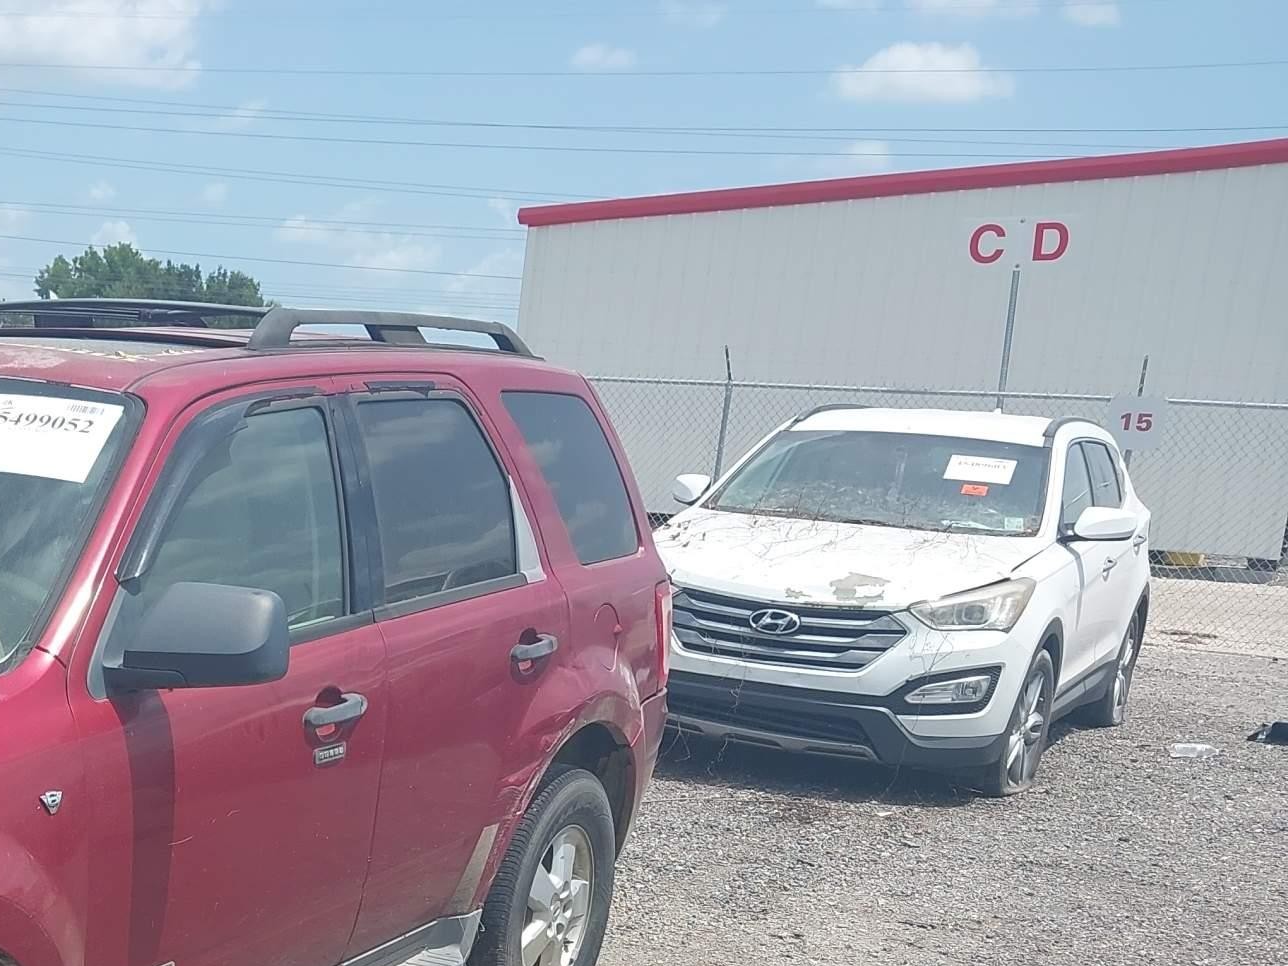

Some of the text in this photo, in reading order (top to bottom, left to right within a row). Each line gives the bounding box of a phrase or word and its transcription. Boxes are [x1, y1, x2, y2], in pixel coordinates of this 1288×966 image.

[968, 221, 1070, 264] C D
[1119, 412, 1154, 432] 15
